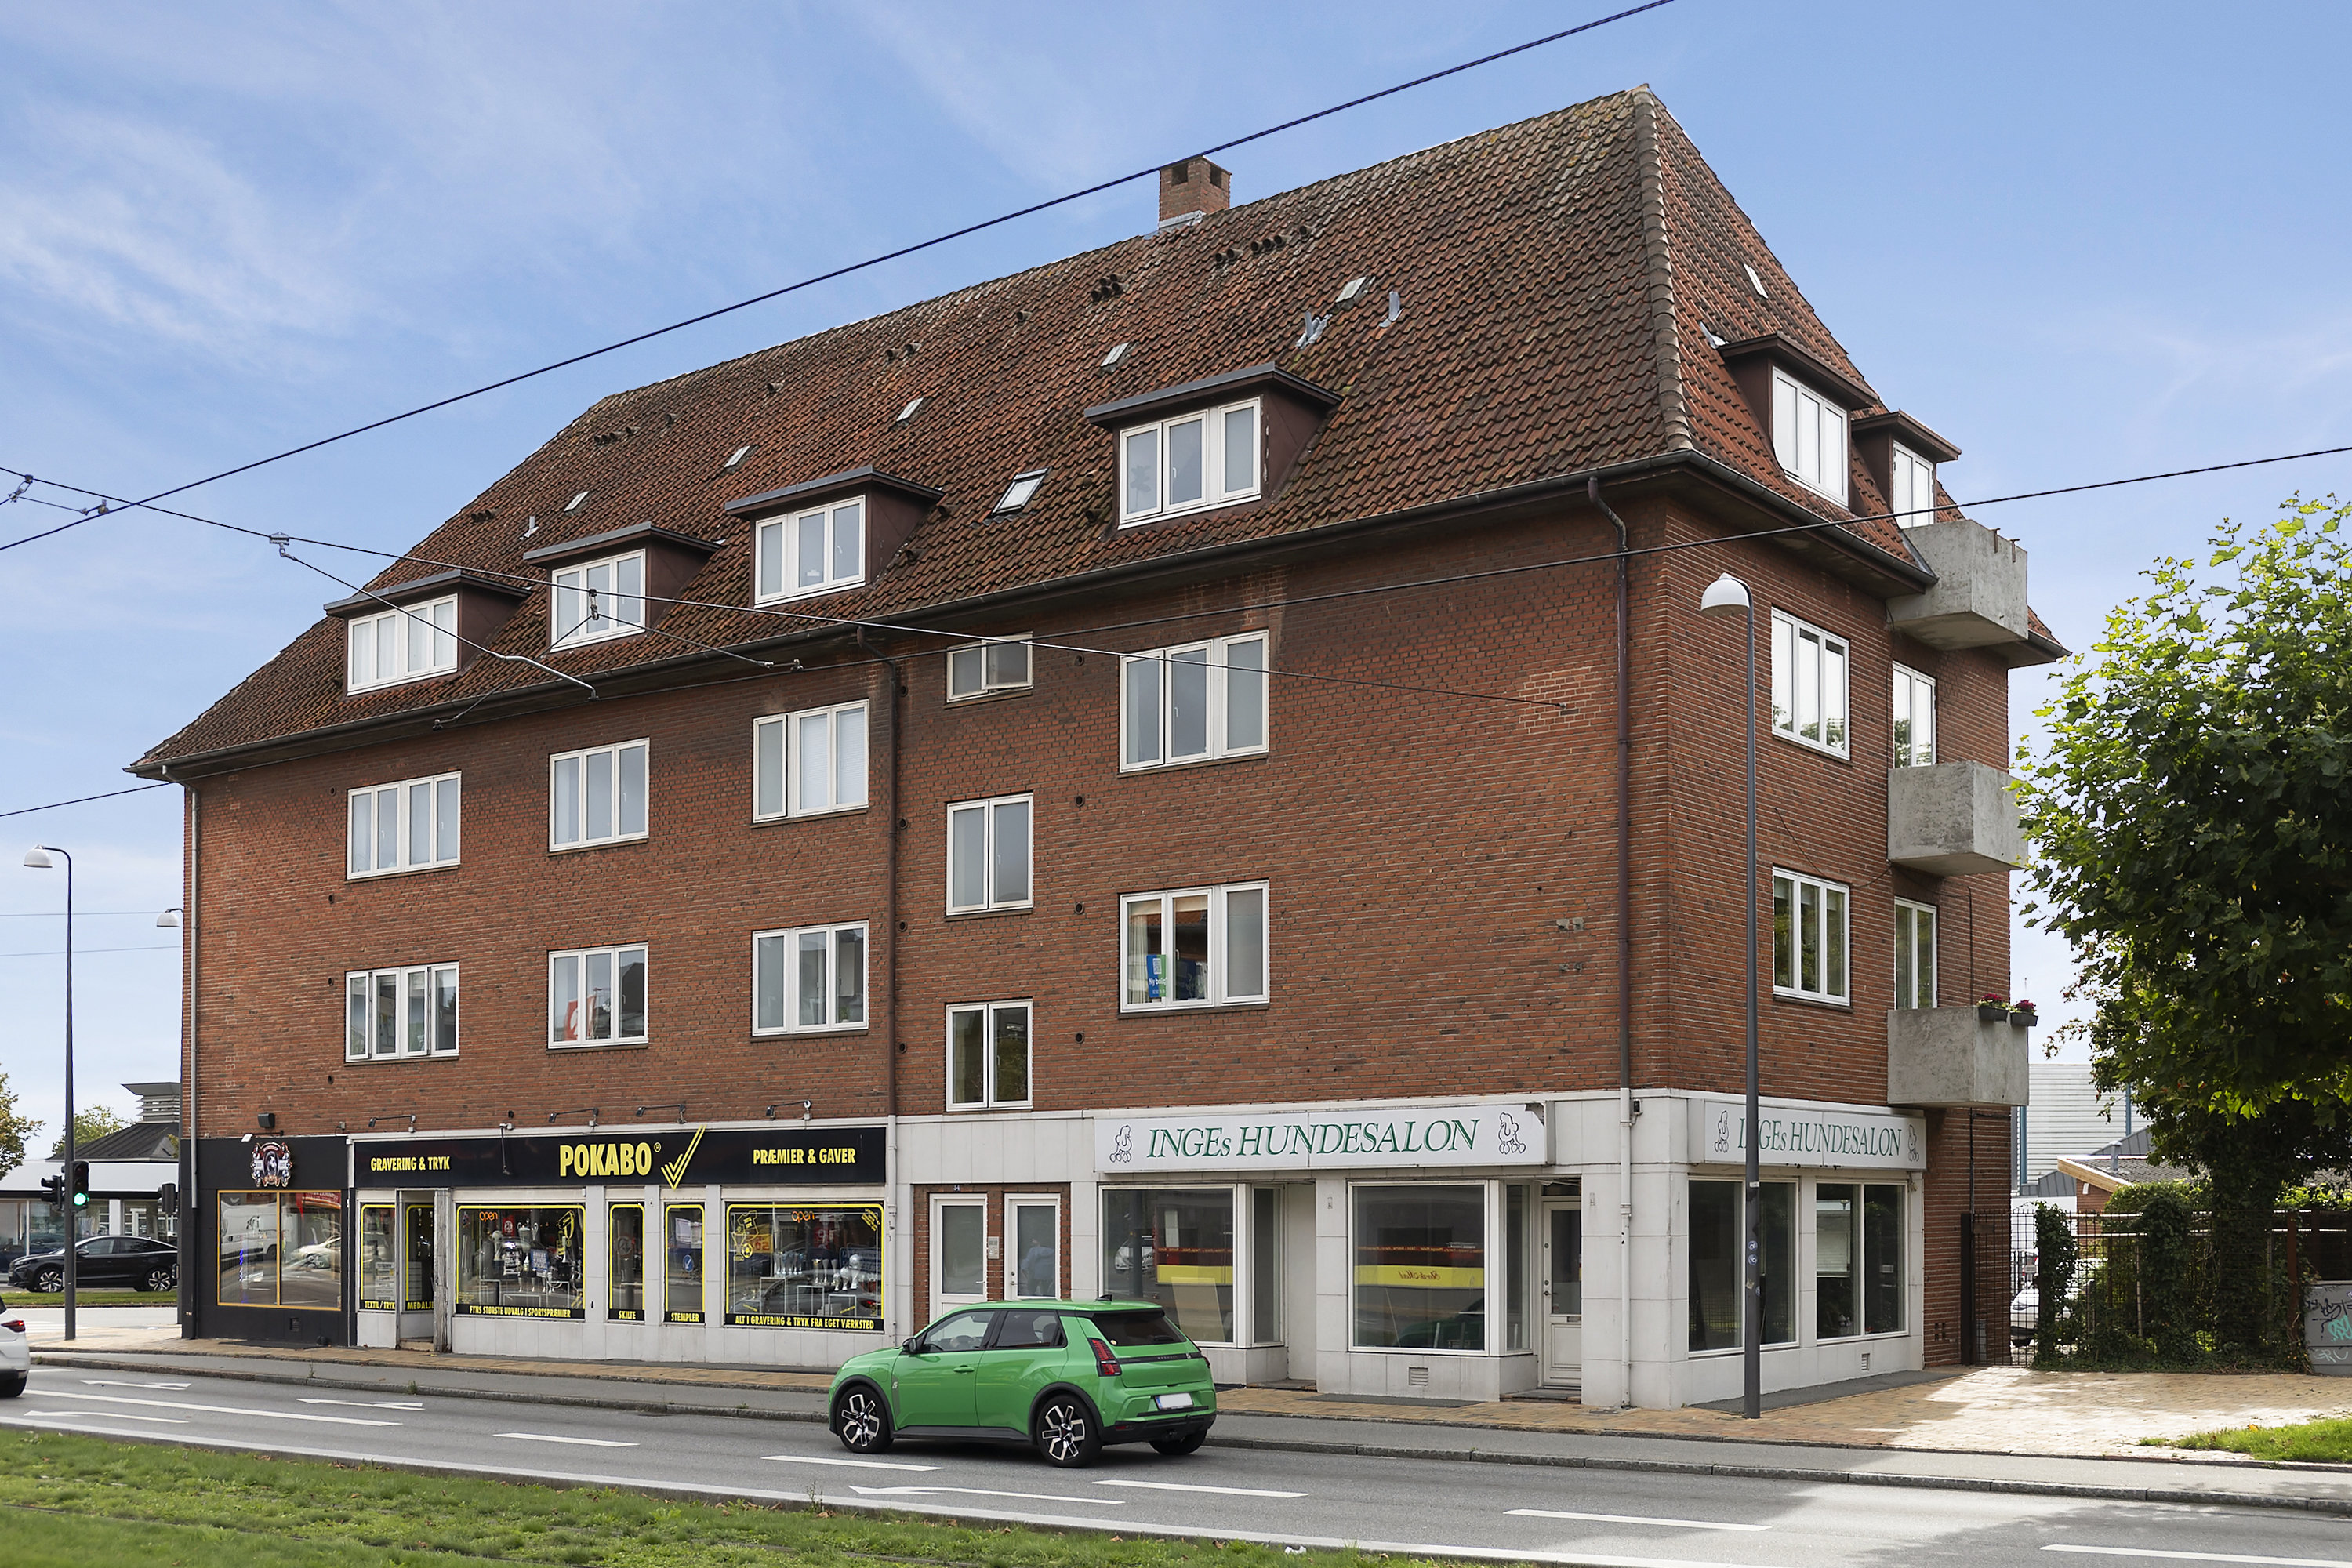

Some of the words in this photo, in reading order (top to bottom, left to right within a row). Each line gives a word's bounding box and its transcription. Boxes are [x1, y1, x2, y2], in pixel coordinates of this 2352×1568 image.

[1146, 1127, 1232, 1158] INGEs
[1236, 1119, 1481, 1156] HUNDESALON
[1737, 1118, 1787, 1151] IGEs
[1789, 1121, 1902, 1156] HUNDESALON
[370, 1157, 417, 1171] GRAVERING
[419, 1156, 426, 1171] &
[427, 1156, 450, 1170] TRYK
[559, 1142, 652, 1176] POKABO
[753, 1149, 804, 1164] PRÆMIER
[808, 1149, 816, 1164] &
[818, 1148, 855, 1163] GAVER
[479, 1211, 499, 1222] open
[791, 1211, 815, 1223] open
[470, 1305, 481, 1314] FYNS
[504, 1307, 524, 1316] UDVALG
[528, 1308, 571, 1317] SPORTSPRÆMIER
[619, 1310, 636, 1319] SKILTE
[671, 1312, 699, 1322] STEMPLER
[735, 1315, 745, 1324] ALT
[751, 1316, 785, 1326] GRAVERING
[786, 1317, 791, 1326] &
[793, 1317, 809, 1327] TRYK
[811, 1318, 822, 1327] FRA
[824, 1318, 840, 1328] EGET
[841, 1319, 874, 1330] VÆRKSTED
